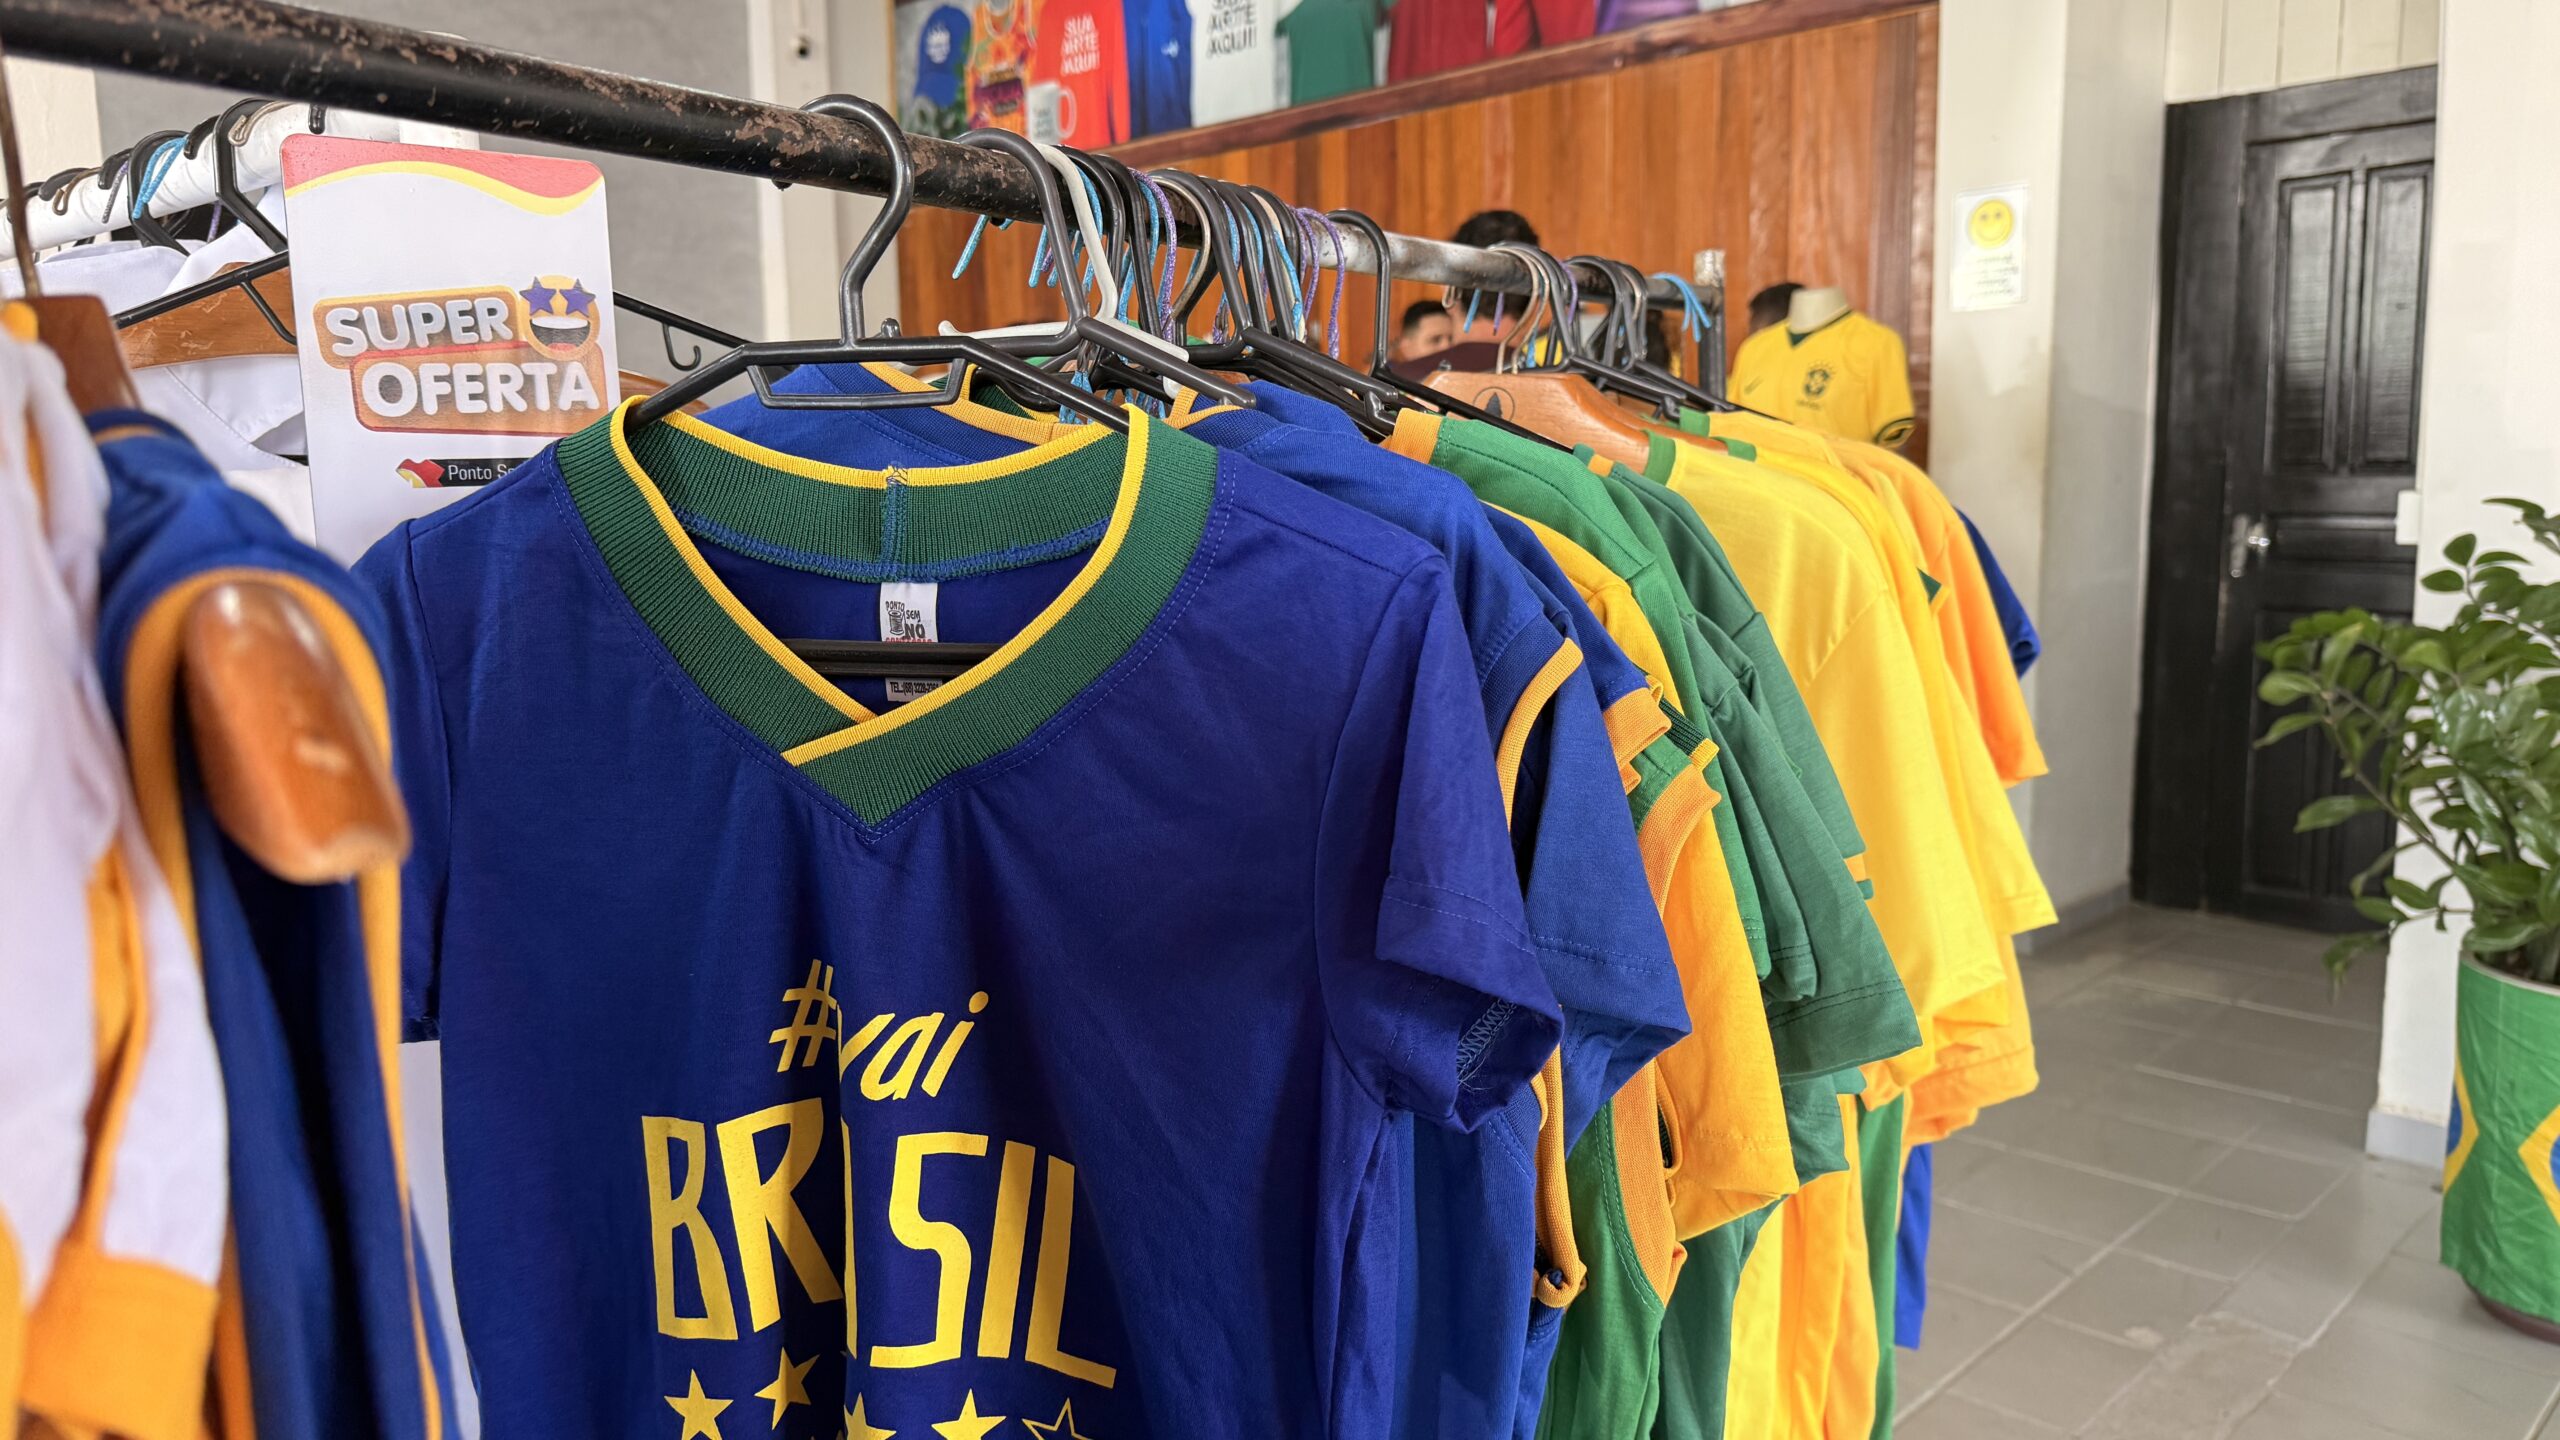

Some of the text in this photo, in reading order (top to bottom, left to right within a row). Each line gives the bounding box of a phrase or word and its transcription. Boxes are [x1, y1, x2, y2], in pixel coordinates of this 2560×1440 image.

[325, 297, 514, 357] SUPER
[361, 361, 600, 418] OFERTA
[448, 464, 492, 480] Ponto
[885, 601, 905, 612] PONTO
[906, 609, 921, 622] SEM
[768, 958, 989, 1101] #vai
[641, 1097, 1117, 1389] BRSIL
